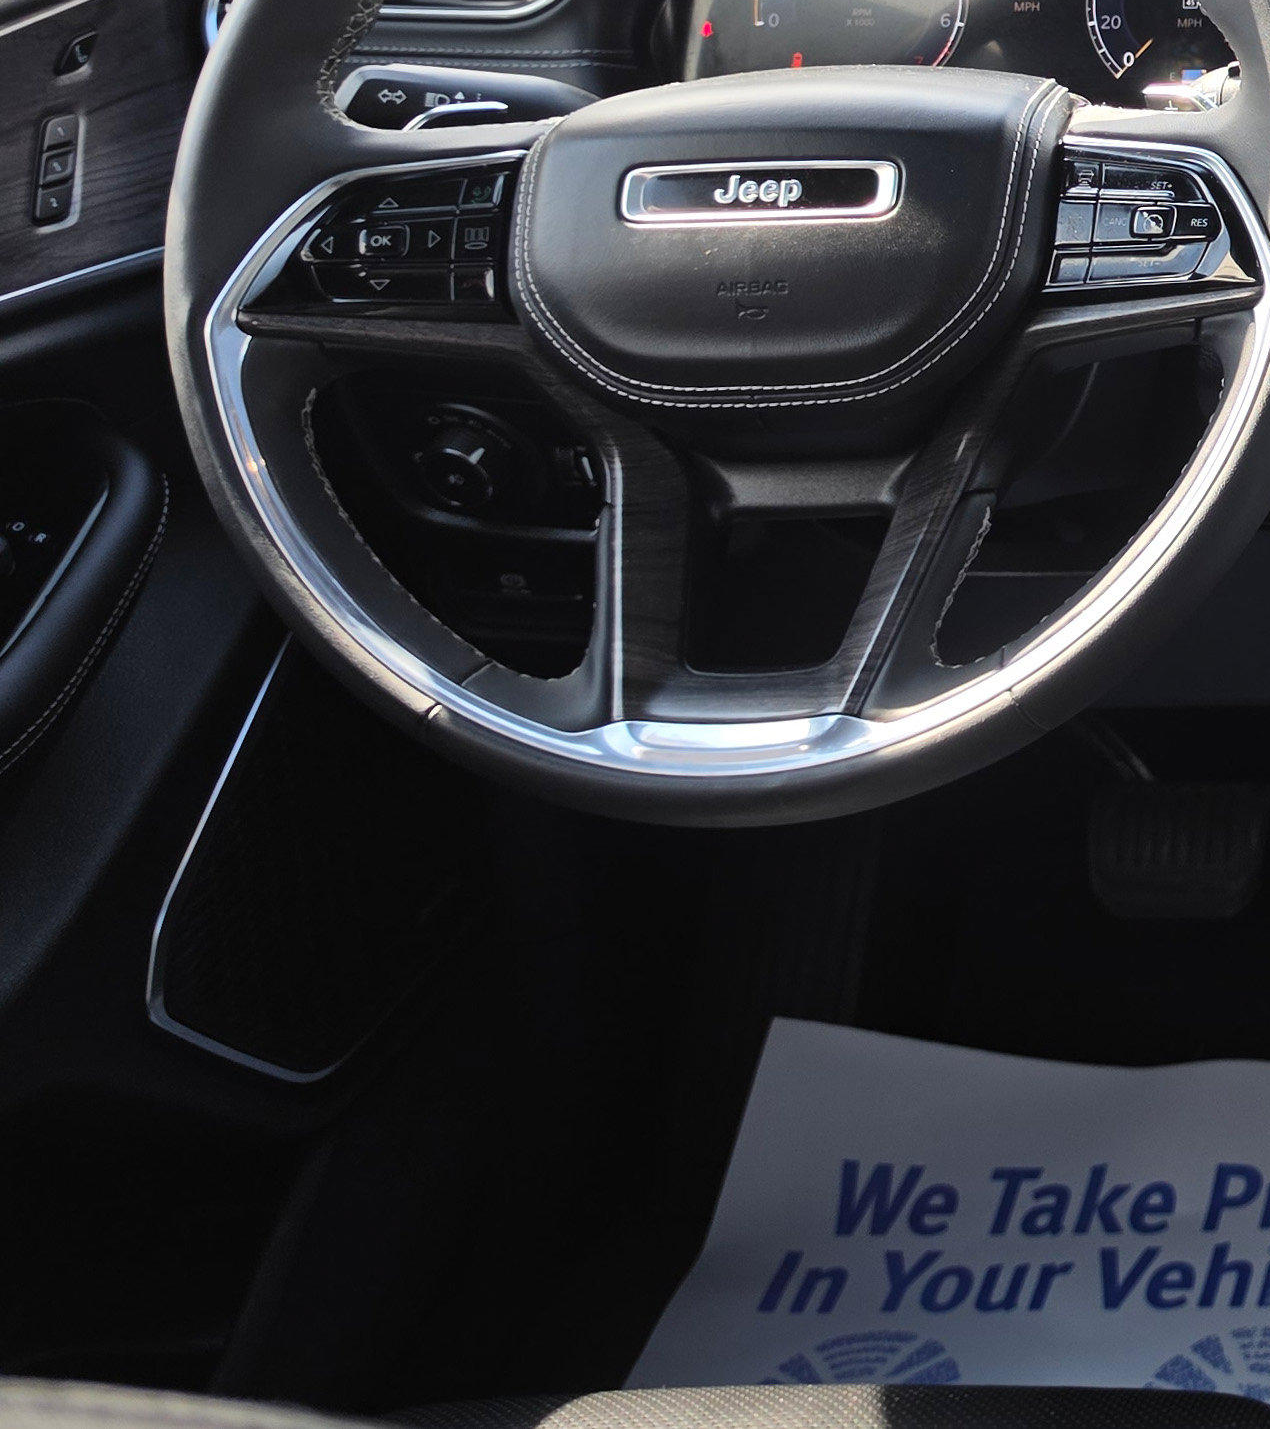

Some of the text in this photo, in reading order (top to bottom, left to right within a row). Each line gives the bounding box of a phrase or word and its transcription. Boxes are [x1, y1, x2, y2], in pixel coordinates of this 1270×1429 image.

[852, 8, 872, 17] RPM
[1013, 2, 1040, 12] MPH
[768, 13, 780, 27] 0
[940, 13, 951, 27] 6
[1101, 15, 1122, 30] 20
[1177, 18, 1203, 28] MPH
[1123, 52, 1135, 67] 0
[713, 174, 803, 208] Jeep
[1190, 217, 1208, 228] RES
[370, 235, 392, 247] OK
[715, 280, 790, 298] AIRBAG
[832, 1159, 960, 1240] We
[986, 1162, 1178, 1240] Take
[756, 1249, 848, 1317] In
[877, 1246, 1073, 1317] Your
